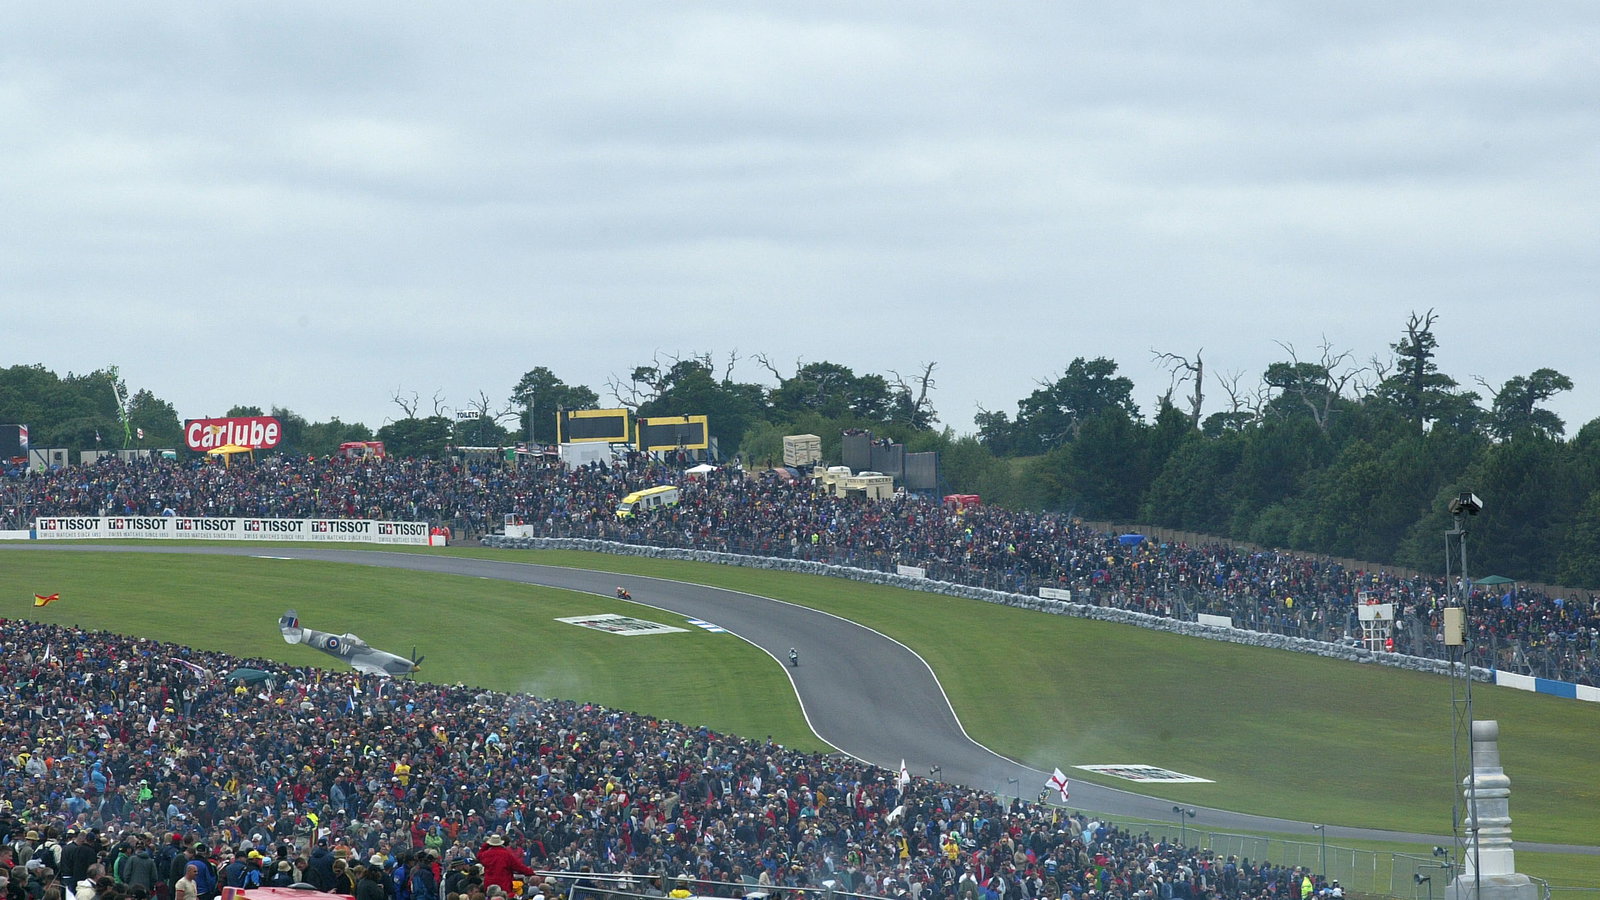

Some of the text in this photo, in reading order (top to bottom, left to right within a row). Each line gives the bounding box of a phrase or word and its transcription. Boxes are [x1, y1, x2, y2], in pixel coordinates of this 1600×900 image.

[188, 420, 278, 448] Carlube
[57, 519, 100, 530] TISSOT
[125, 519, 167, 529] TISSOT
[193, 520, 236, 530] TISSOT
[261, 521, 303, 531] TISSOT
[328, 522, 370, 532] TISSOT
[394, 524, 426, 535] TISSOT
[340, 642, 351, 656] W
